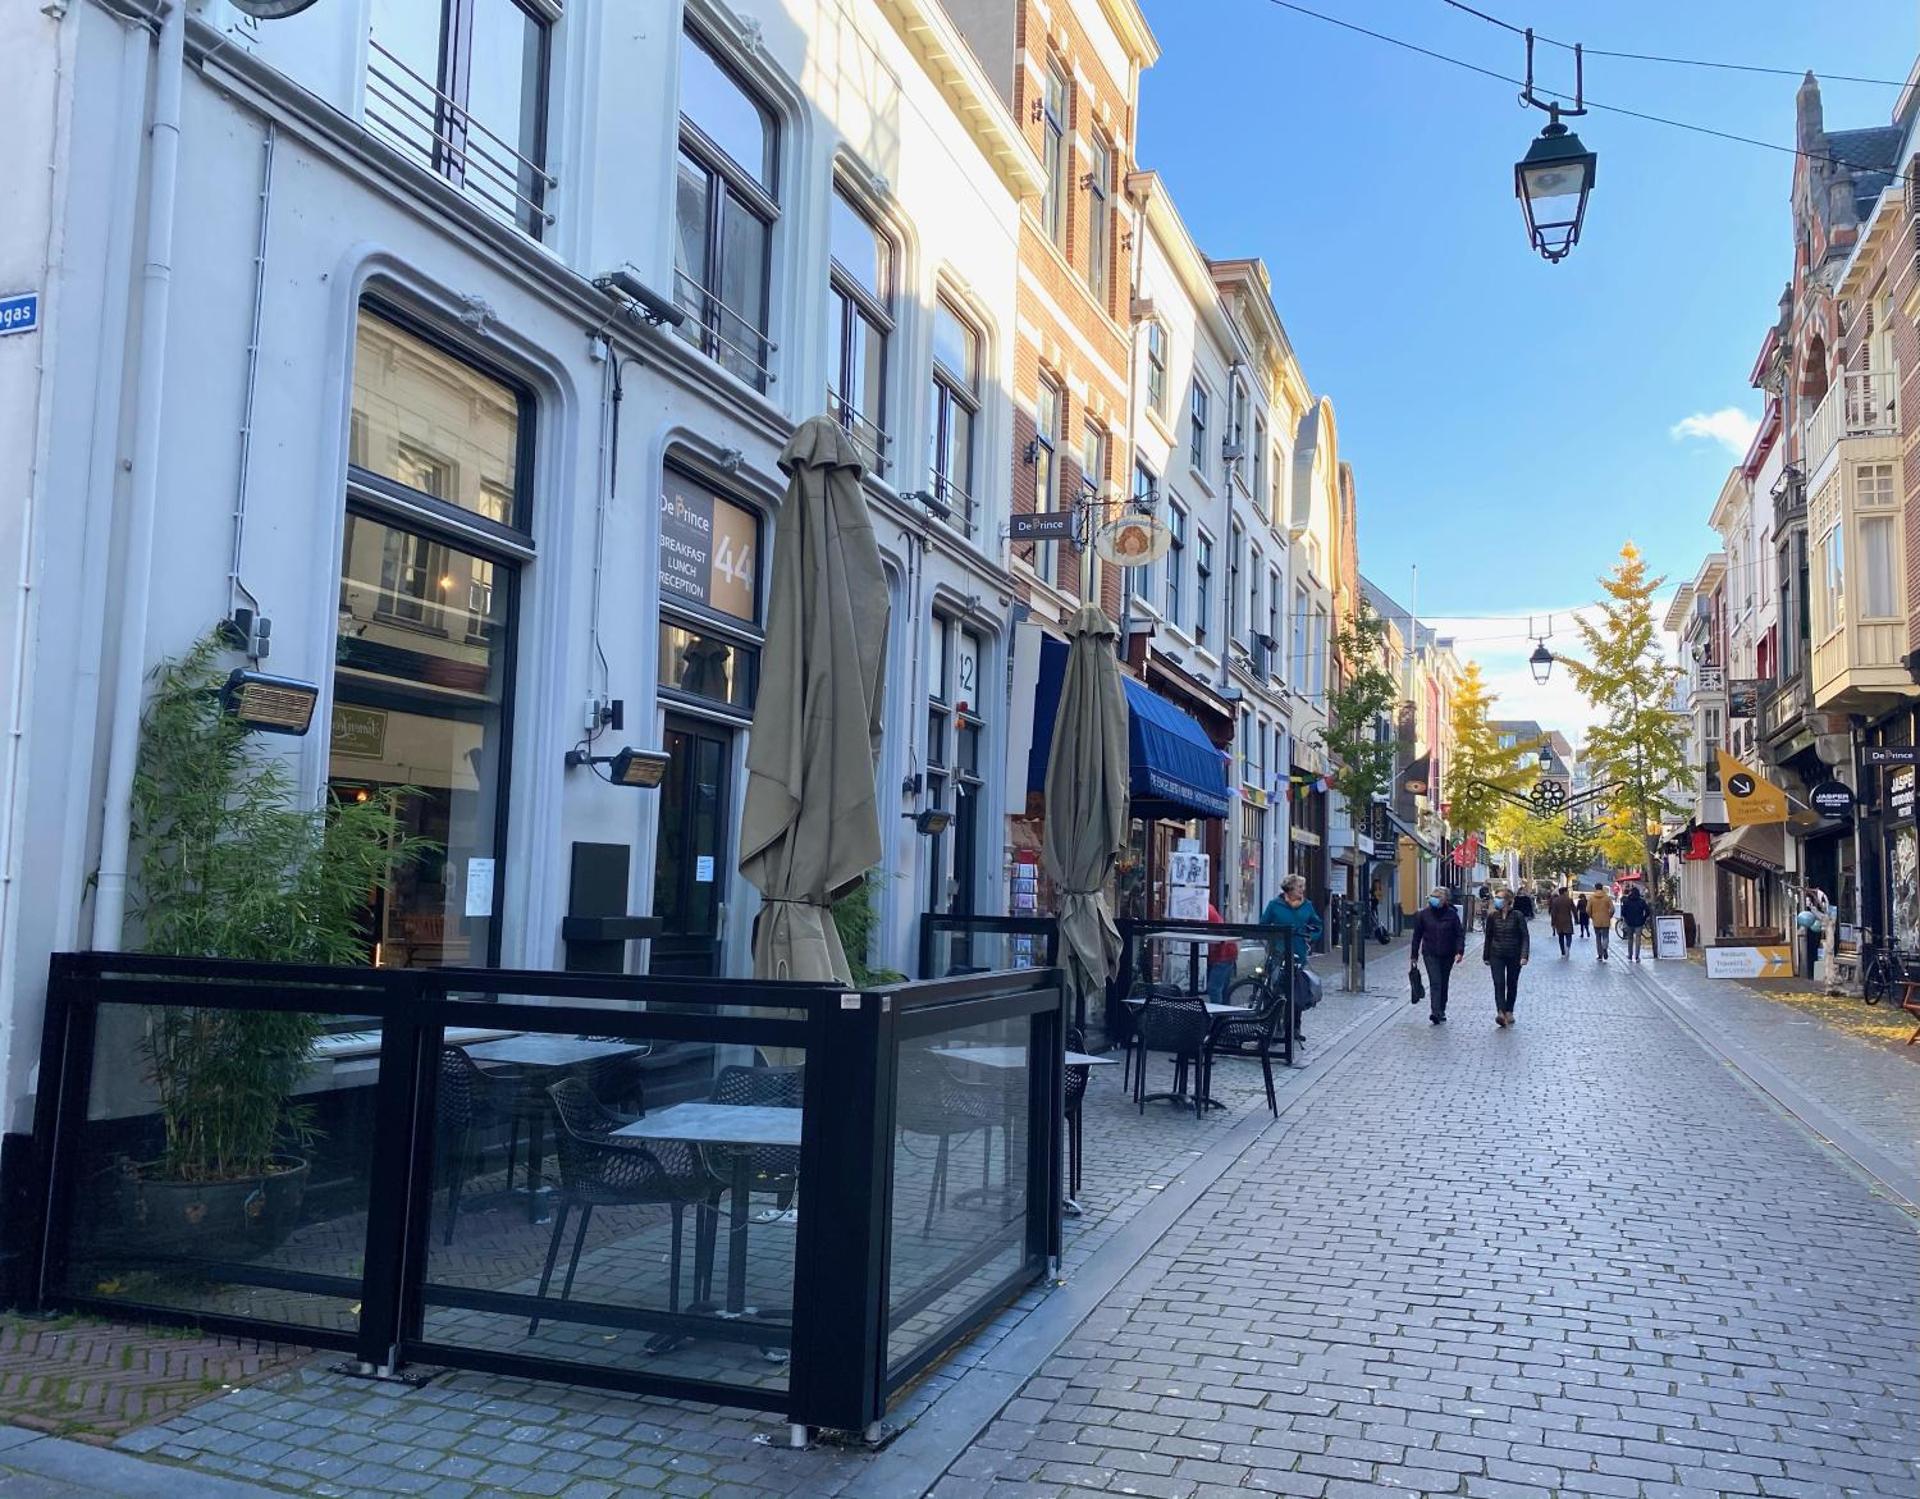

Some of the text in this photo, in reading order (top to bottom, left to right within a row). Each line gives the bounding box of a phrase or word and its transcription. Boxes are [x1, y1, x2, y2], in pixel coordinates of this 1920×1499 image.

[0, 305, 30, 328] gas
[660, 494, 709, 531] De Prince
[1018, 518, 1064, 531] De Prince
[659, 534, 706, 564] BREAKFAST
[668, 556, 697, 578] LUNCH
[714, 535, 752, 592] 44
[659, 571, 704, 598] RECEPTION
